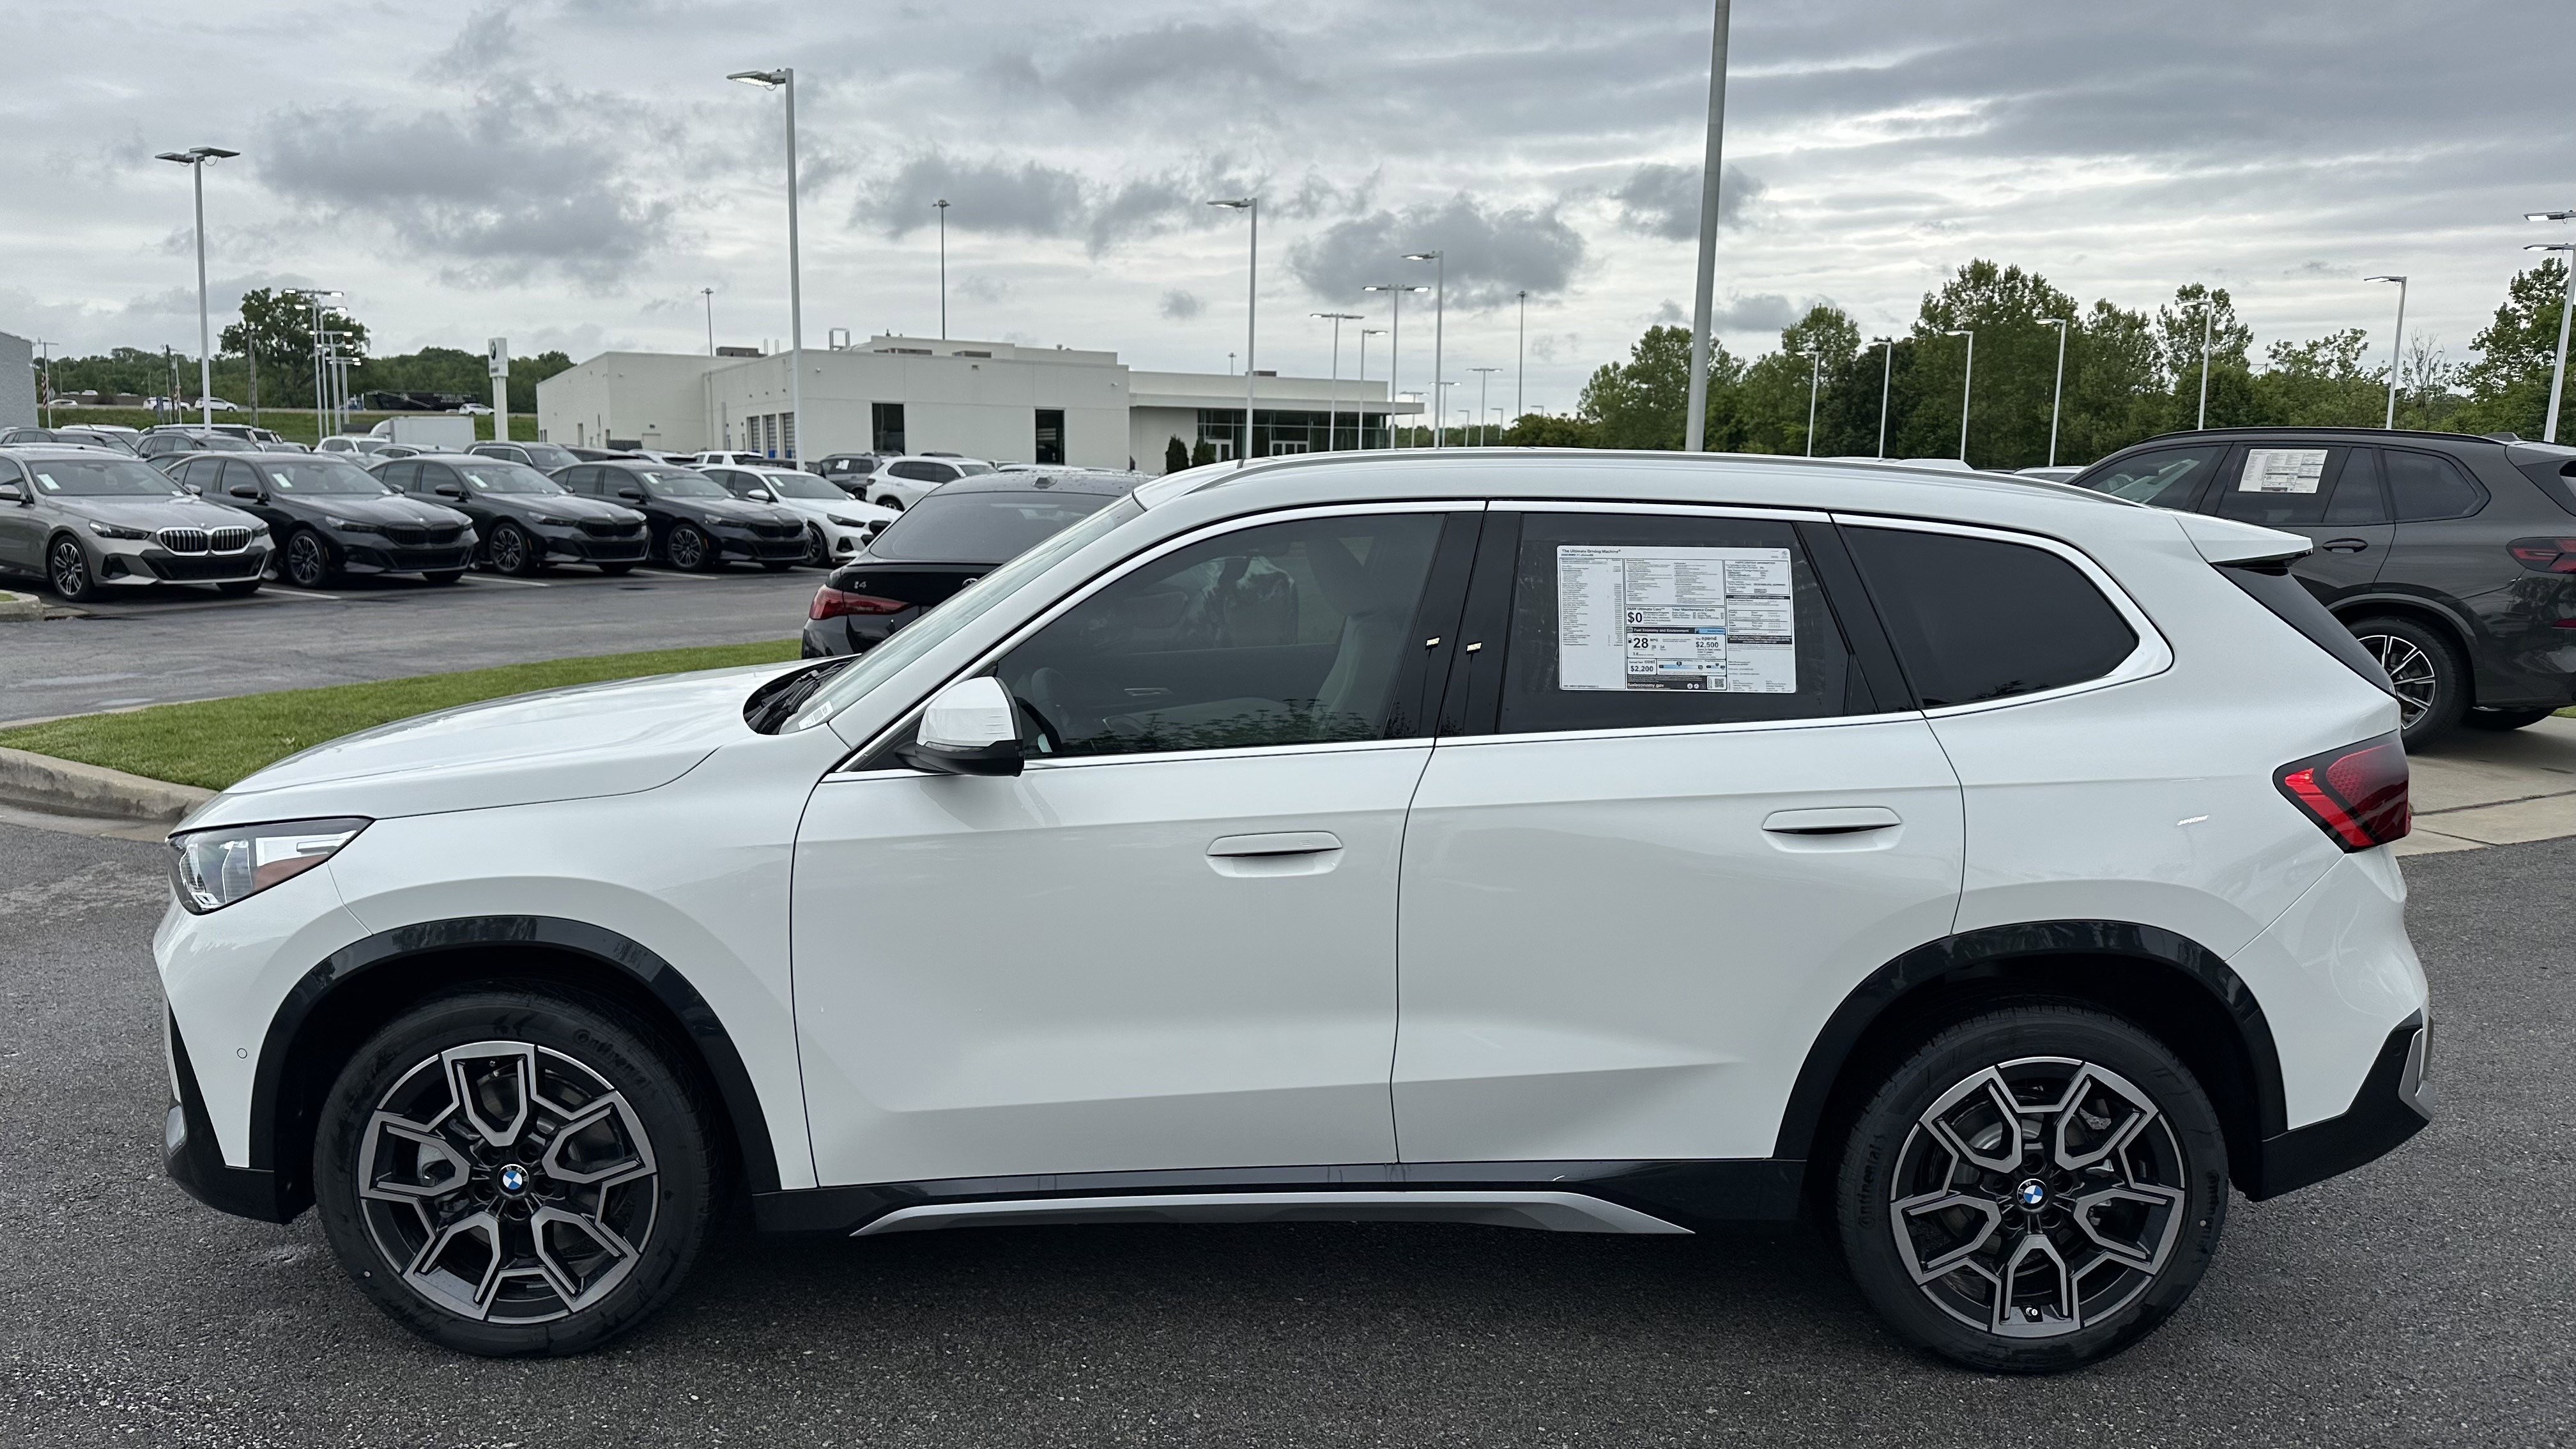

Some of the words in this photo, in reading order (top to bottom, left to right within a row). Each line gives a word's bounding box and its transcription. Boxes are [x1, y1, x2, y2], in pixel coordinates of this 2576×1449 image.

[506, 527, 528, 543] BMW
[854, 581, 866, 589] i4
[1627, 611, 1643, 624] $0
[1633, 638, 1648, 648] 28
[2019, 1181, 2032, 1204] BMW
